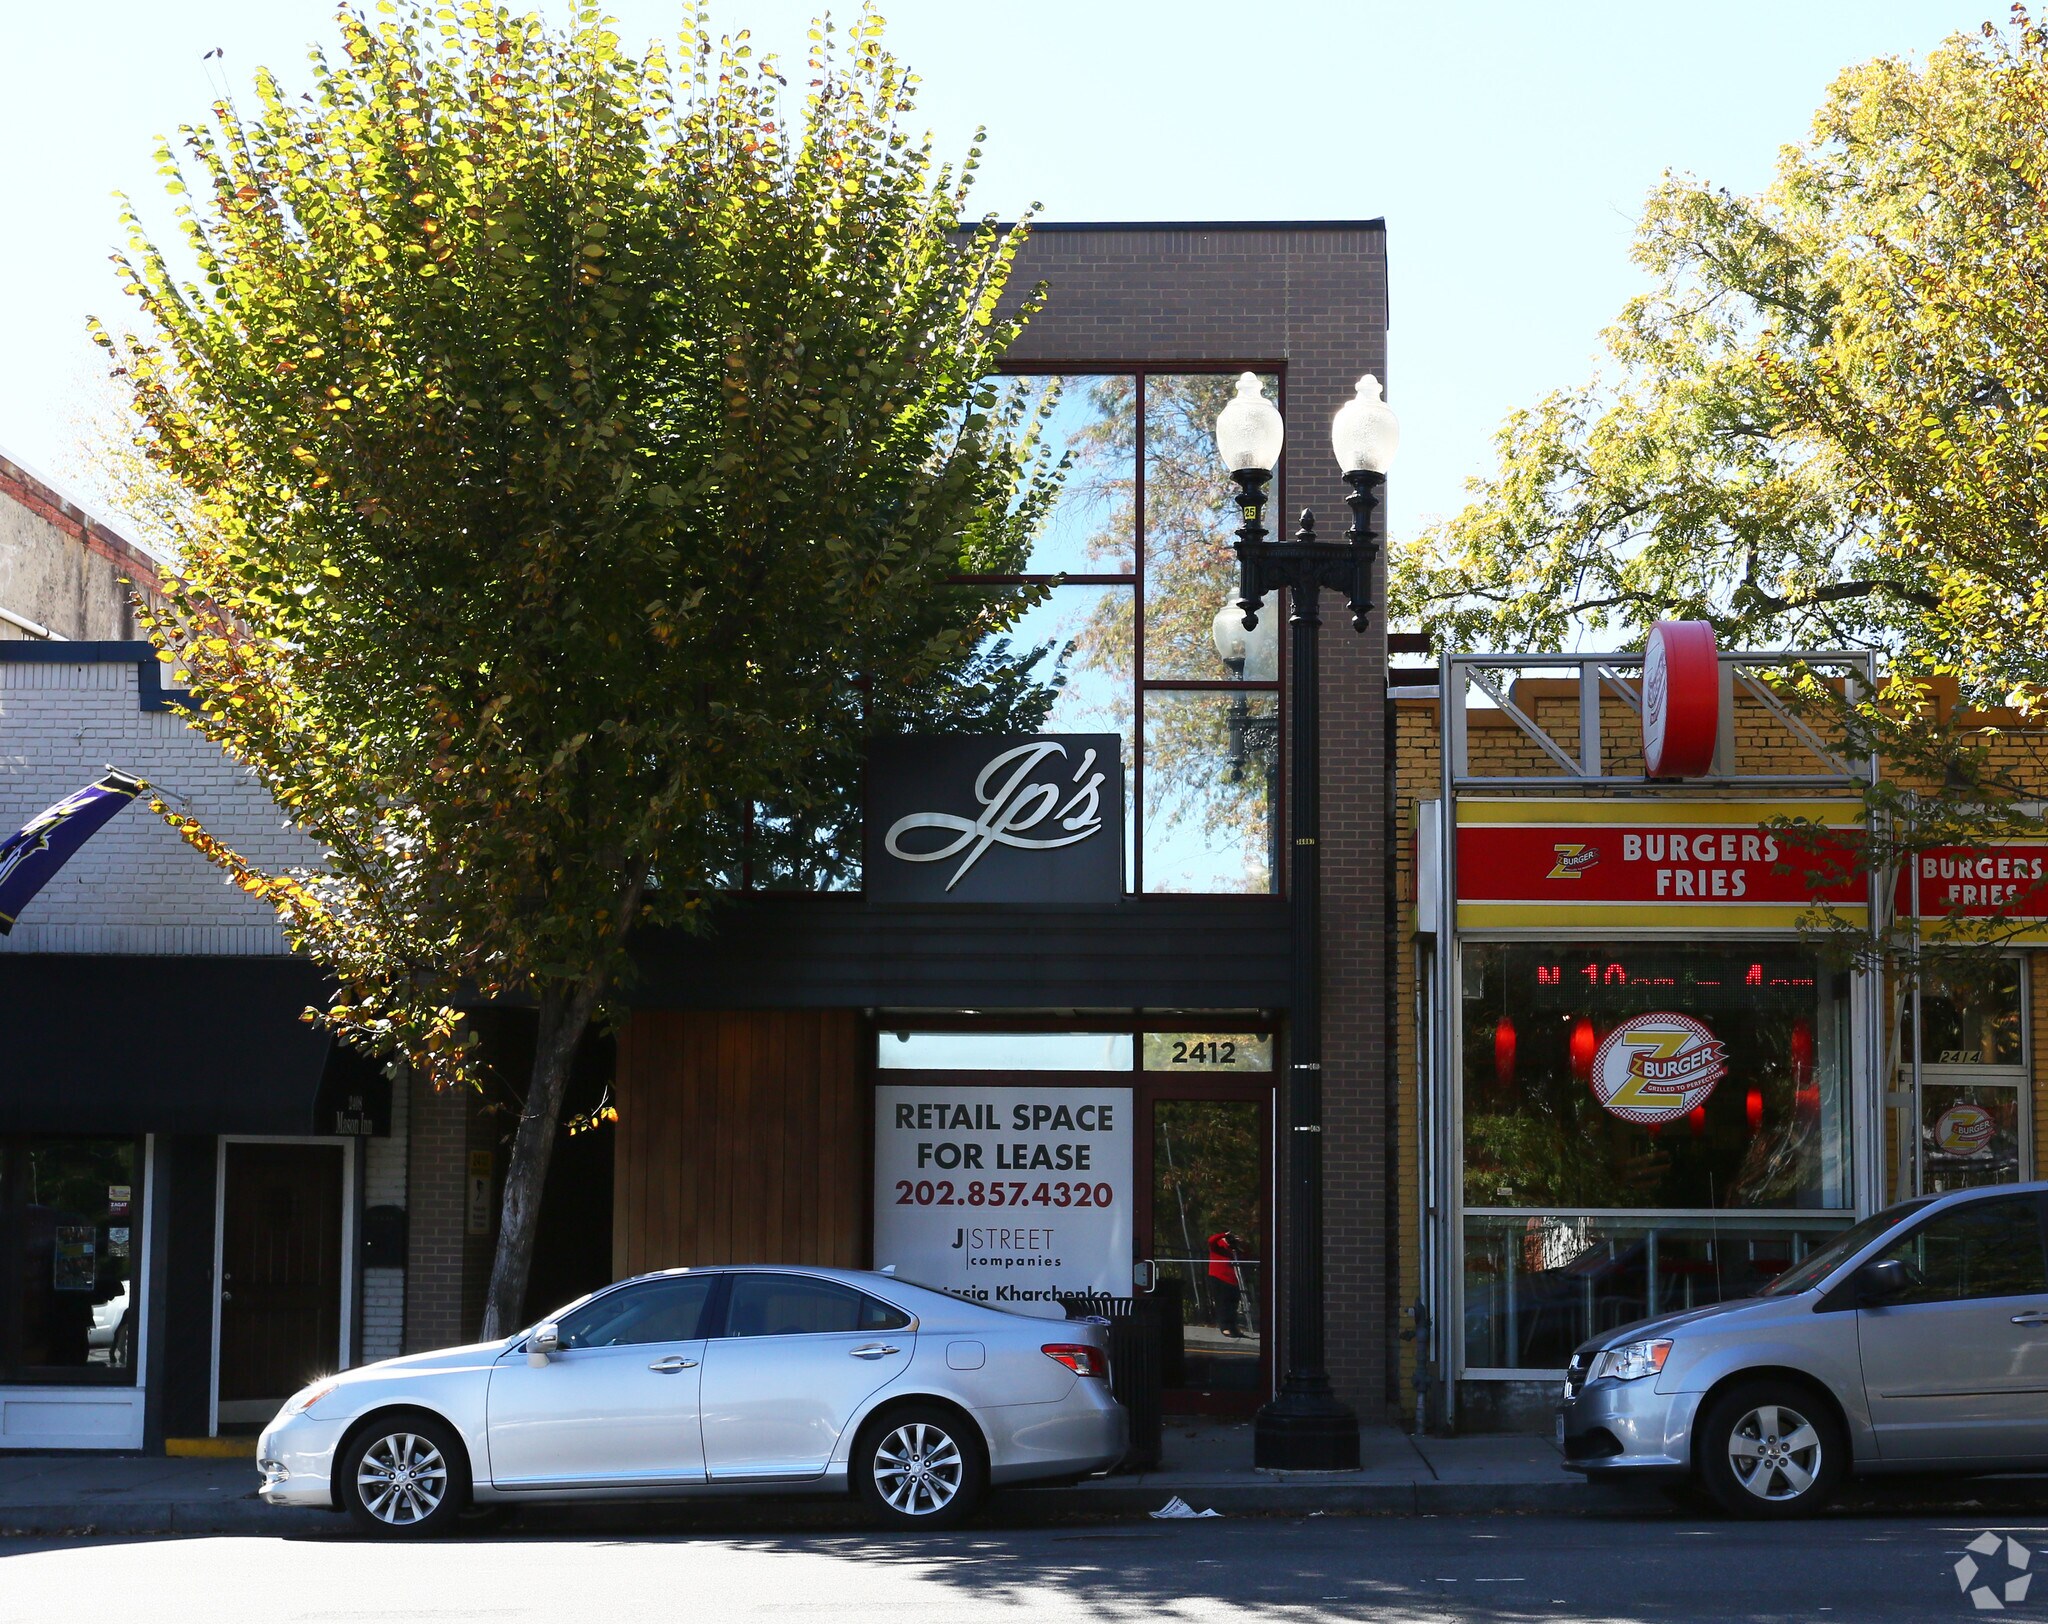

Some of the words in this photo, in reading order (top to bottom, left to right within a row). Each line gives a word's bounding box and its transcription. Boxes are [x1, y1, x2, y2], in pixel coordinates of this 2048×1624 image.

[1245, 508, 1254, 517] 25
[1623, 834, 1779, 862] BURGERS
[1922, 858, 2042, 880] BURGERS
[1656, 869, 1746, 897] FRIES
[1948, 885, 2017, 906] FRIES
[1172, 1042, 1236, 1064] 2412
[1941, 1052, 1981, 1063] 2414
[1648, 1084, 1675, 1093] GRILLED
[1686, 1070, 1724, 1089] PERFECTION
[336, 1111, 359, 1134] Mason
[360, 1112, 373, 1134] Inn
[895, 1104, 1000, 1130] RETAIL
[1012, 1103, 1114, 1131] SPACE
[917, 1143, 984, 1170] FOR
[997, 1143, 1091, 1170] LEASE
[895, 1181, 1113, 1208] 202.857.4320
[971, 1255, 1061, 1269] companies
[943, 1284, 989, 1301] sia
[996, 1285, 1112, 1302] Kharchenko
